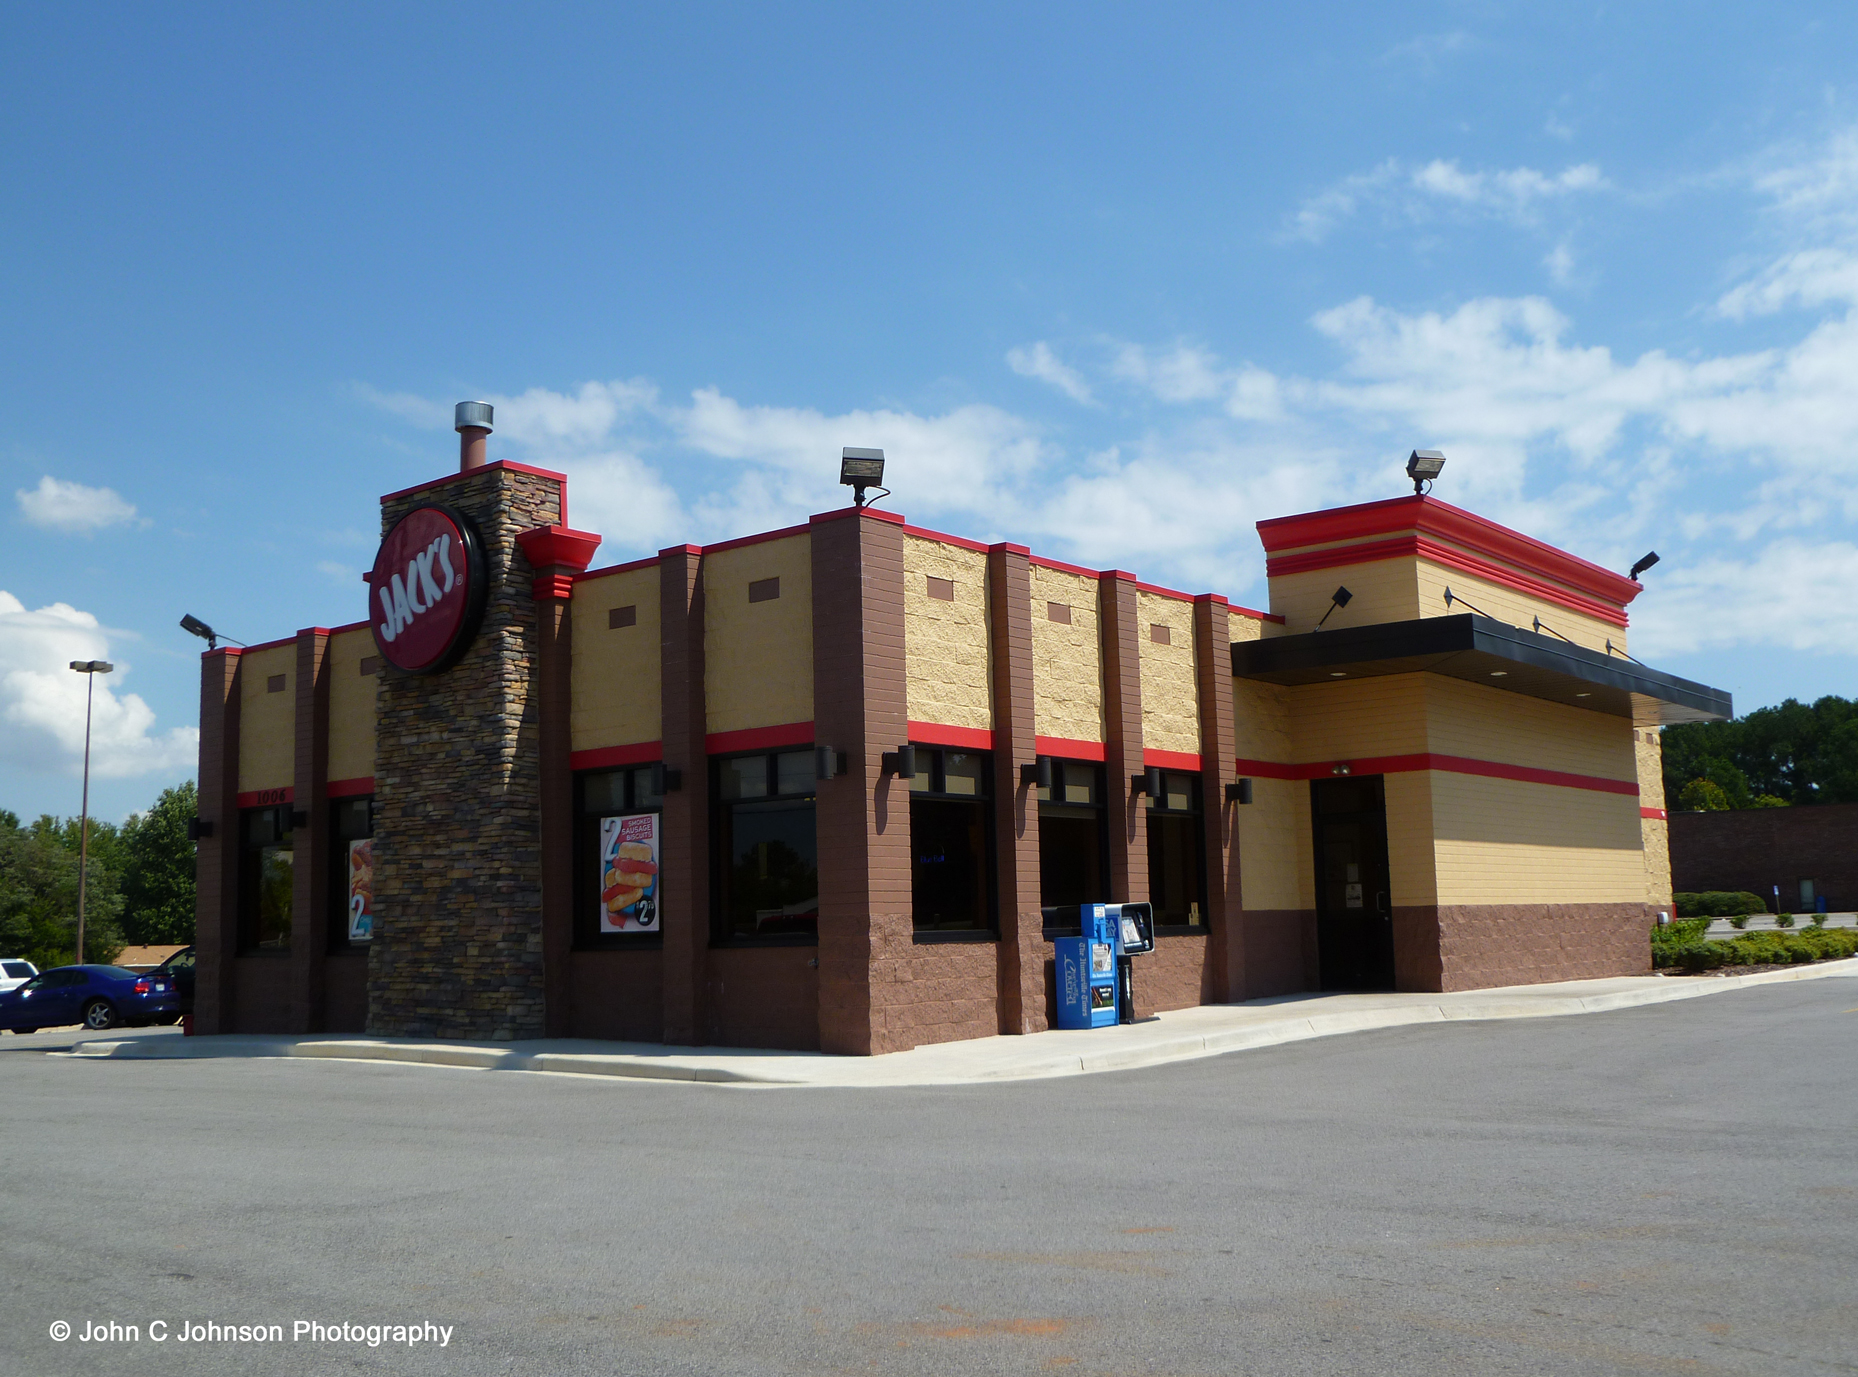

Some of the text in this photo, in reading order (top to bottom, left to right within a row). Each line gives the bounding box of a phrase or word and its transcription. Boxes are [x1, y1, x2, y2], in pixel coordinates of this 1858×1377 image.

[379, 533, 454, 642] JACK'S
[257, 789, 286, 804] 1006
[621, 824, 652, 835] SAUSAGE
[628, 817, 651, 827] SMOKED
[604, 817, 622, 861] 2
[626, 831, 652, 841] BISCUITS
[351, 894, 365, 937] 2
[1078, 942, 1086, 956] The
[1080, 957, 1088, 994] Huntsville
